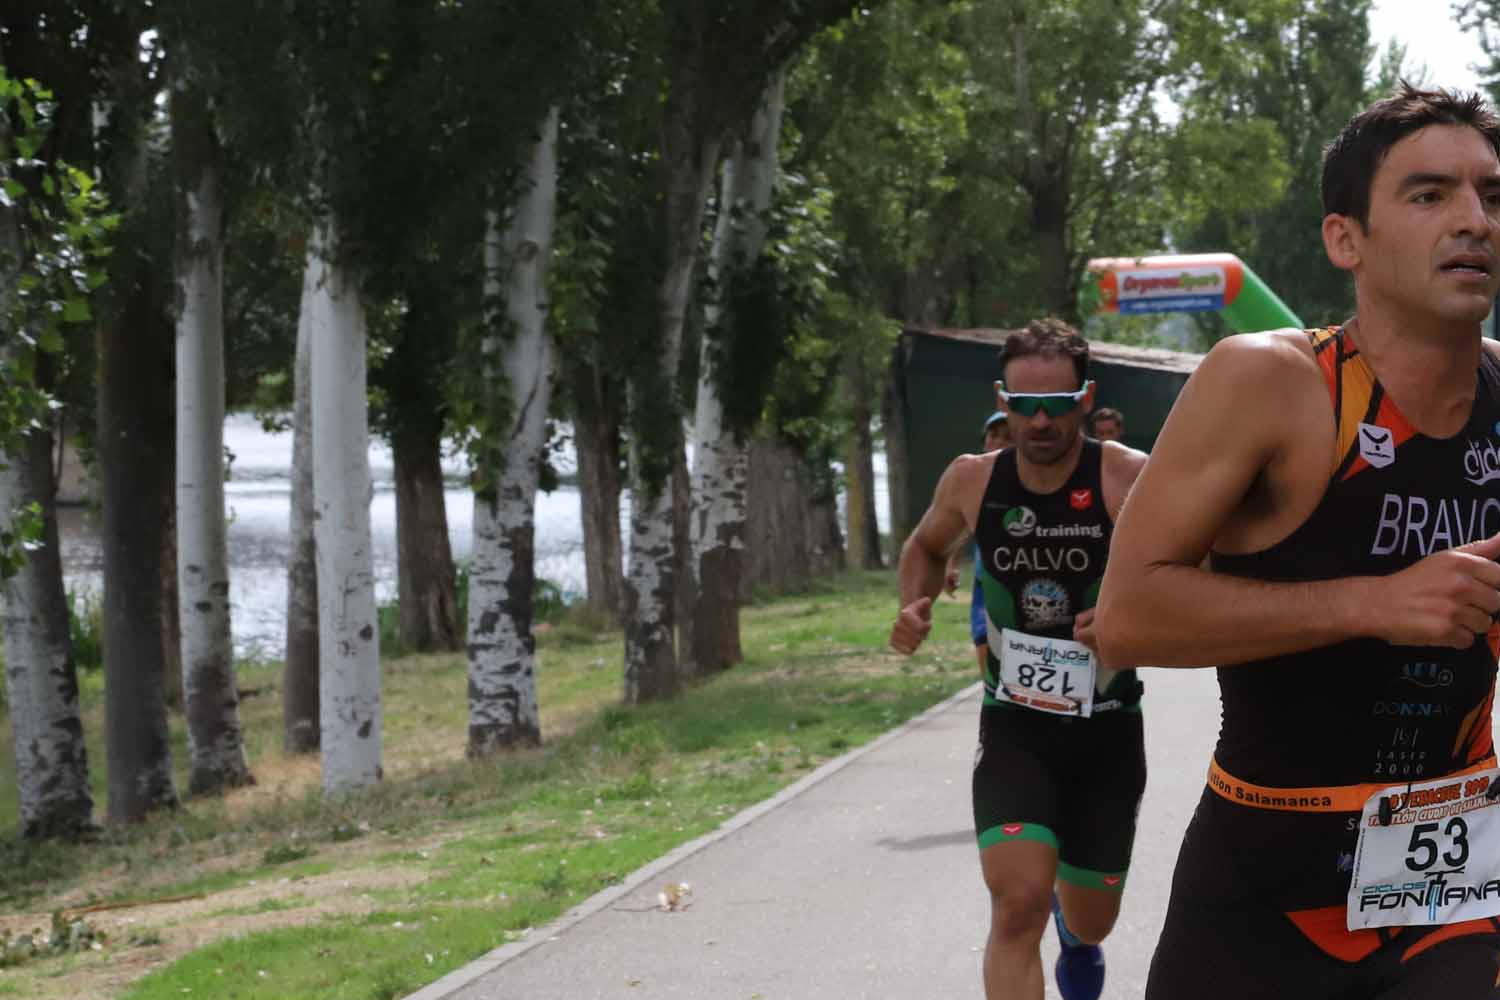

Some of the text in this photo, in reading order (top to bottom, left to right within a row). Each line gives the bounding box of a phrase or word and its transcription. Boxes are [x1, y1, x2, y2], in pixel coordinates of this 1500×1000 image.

[1035, 523, 1104, 538] training
[993, 546, 1090, 572] CALVO
[1017, 663, 1074, 696] 128
[1235, 786, 1332, 807] Salamanca
[1405, 817, 1469, 871] 53
